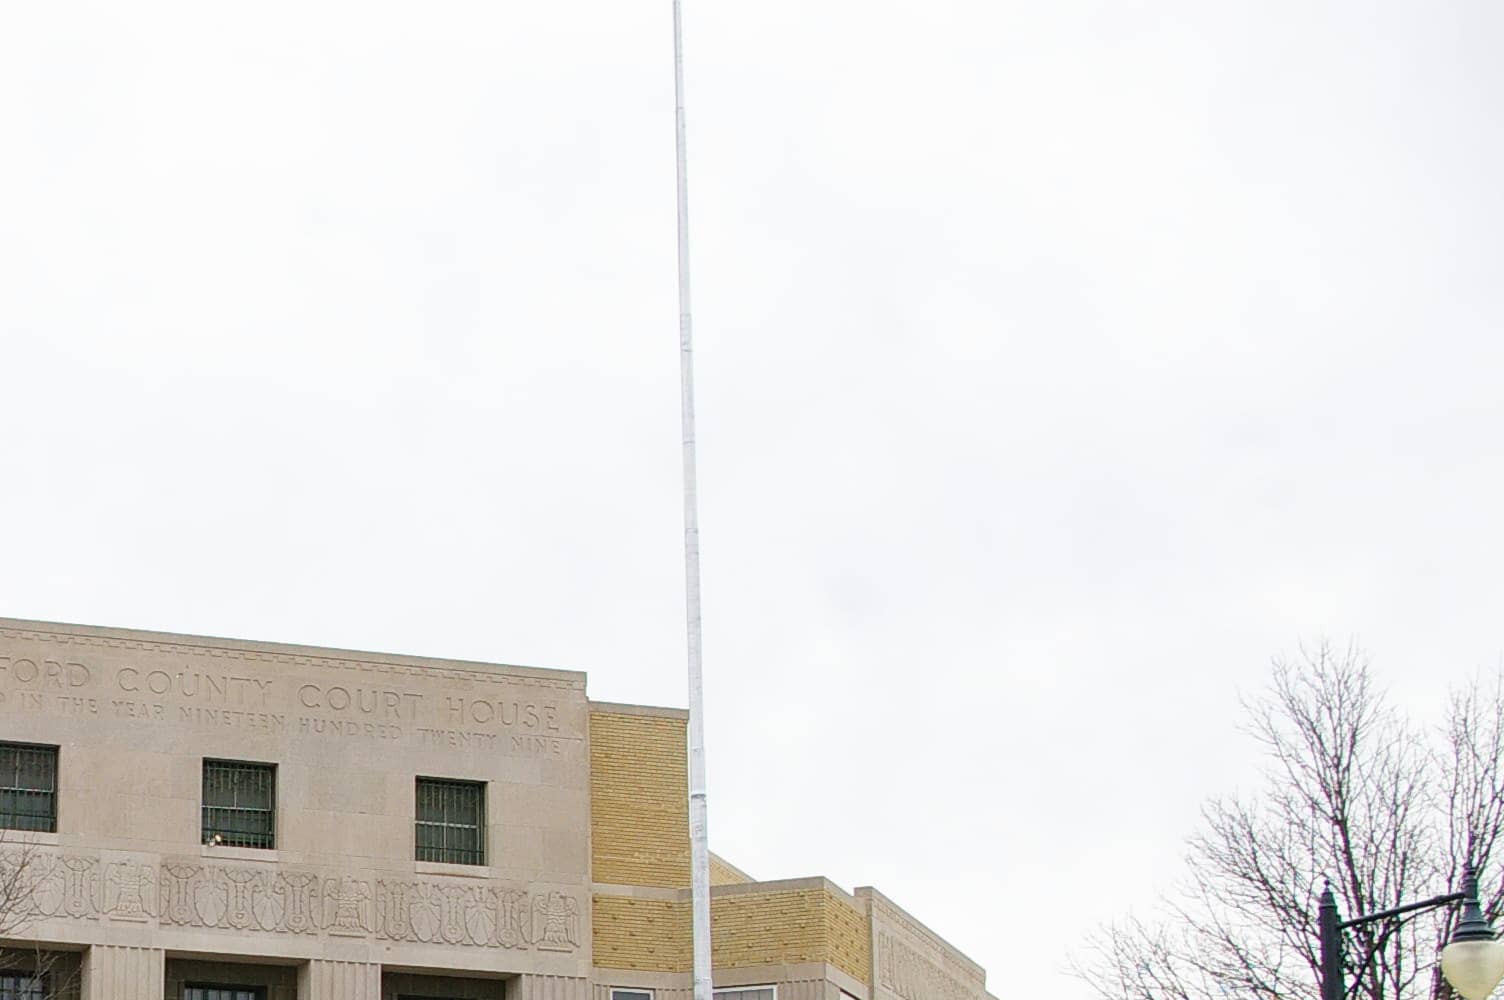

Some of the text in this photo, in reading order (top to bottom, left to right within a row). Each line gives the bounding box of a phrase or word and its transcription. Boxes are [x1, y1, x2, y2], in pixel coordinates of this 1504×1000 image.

[20, 692, 43, 711] IN
[57, 695, 98, 714] THE
[112, 700, 165, 721] YEAR
[179, 706, 285, 735] NINETEEN
[299, 717, 402, 740] HUNDRED
[416, 728, 497, 751] TWENTY
[511, 736, 561, 755] NINE
[116, 667, 273, 706] COUNTY
[297, 684, 424, 720] COURT
[446, 697, 560, 733] HOUSE
